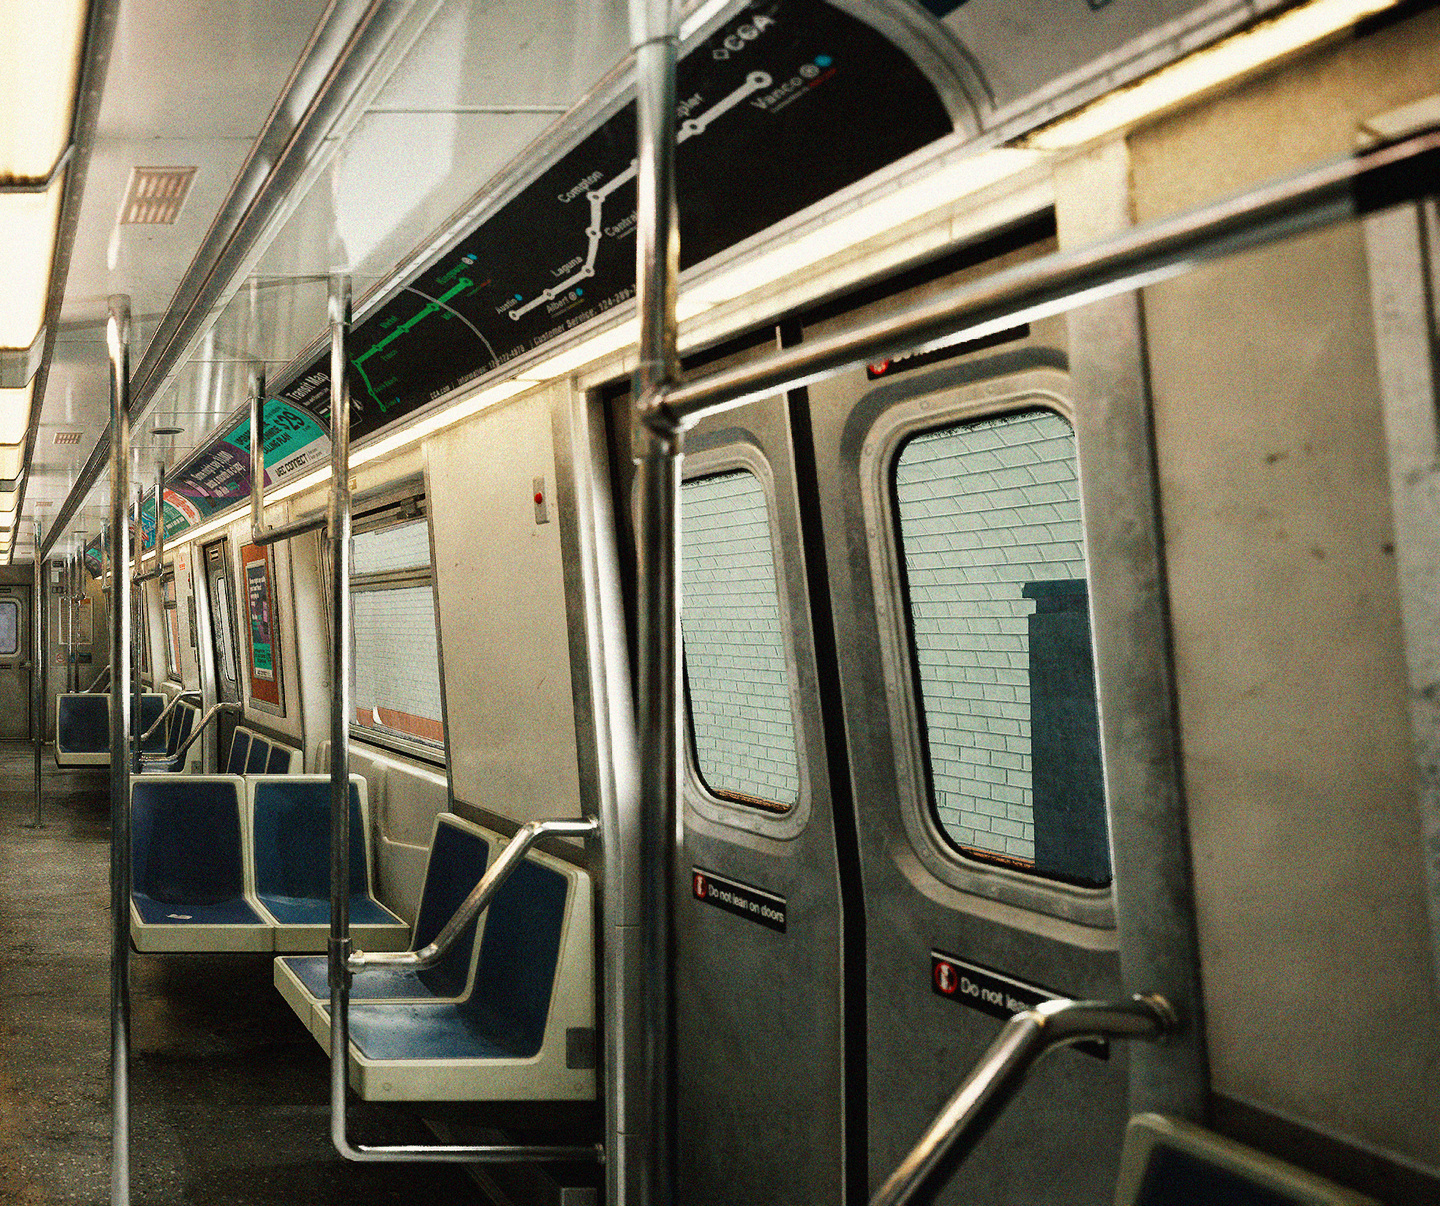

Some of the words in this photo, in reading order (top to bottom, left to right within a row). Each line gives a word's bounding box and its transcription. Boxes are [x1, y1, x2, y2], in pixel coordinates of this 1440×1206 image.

[676, 92, 704, 118] pler
[749, 76, 803, 110] Vanco
[558, 169, 605, 204] Compton
[549, 255, 584, 278] Laguna
[494, 298, 518, 315] Austin
[546, 295, 570, 315] Albert
[708, 883, 720, 899] Do
[719, 891, 732, 904] not
[731, 892, 749, 910] lean
[748, 901, 760, 914] on
[760, 904, 786, 924] doors
[960, 976, 980, 997] Do
[981, 988, 1003, 1007] not
